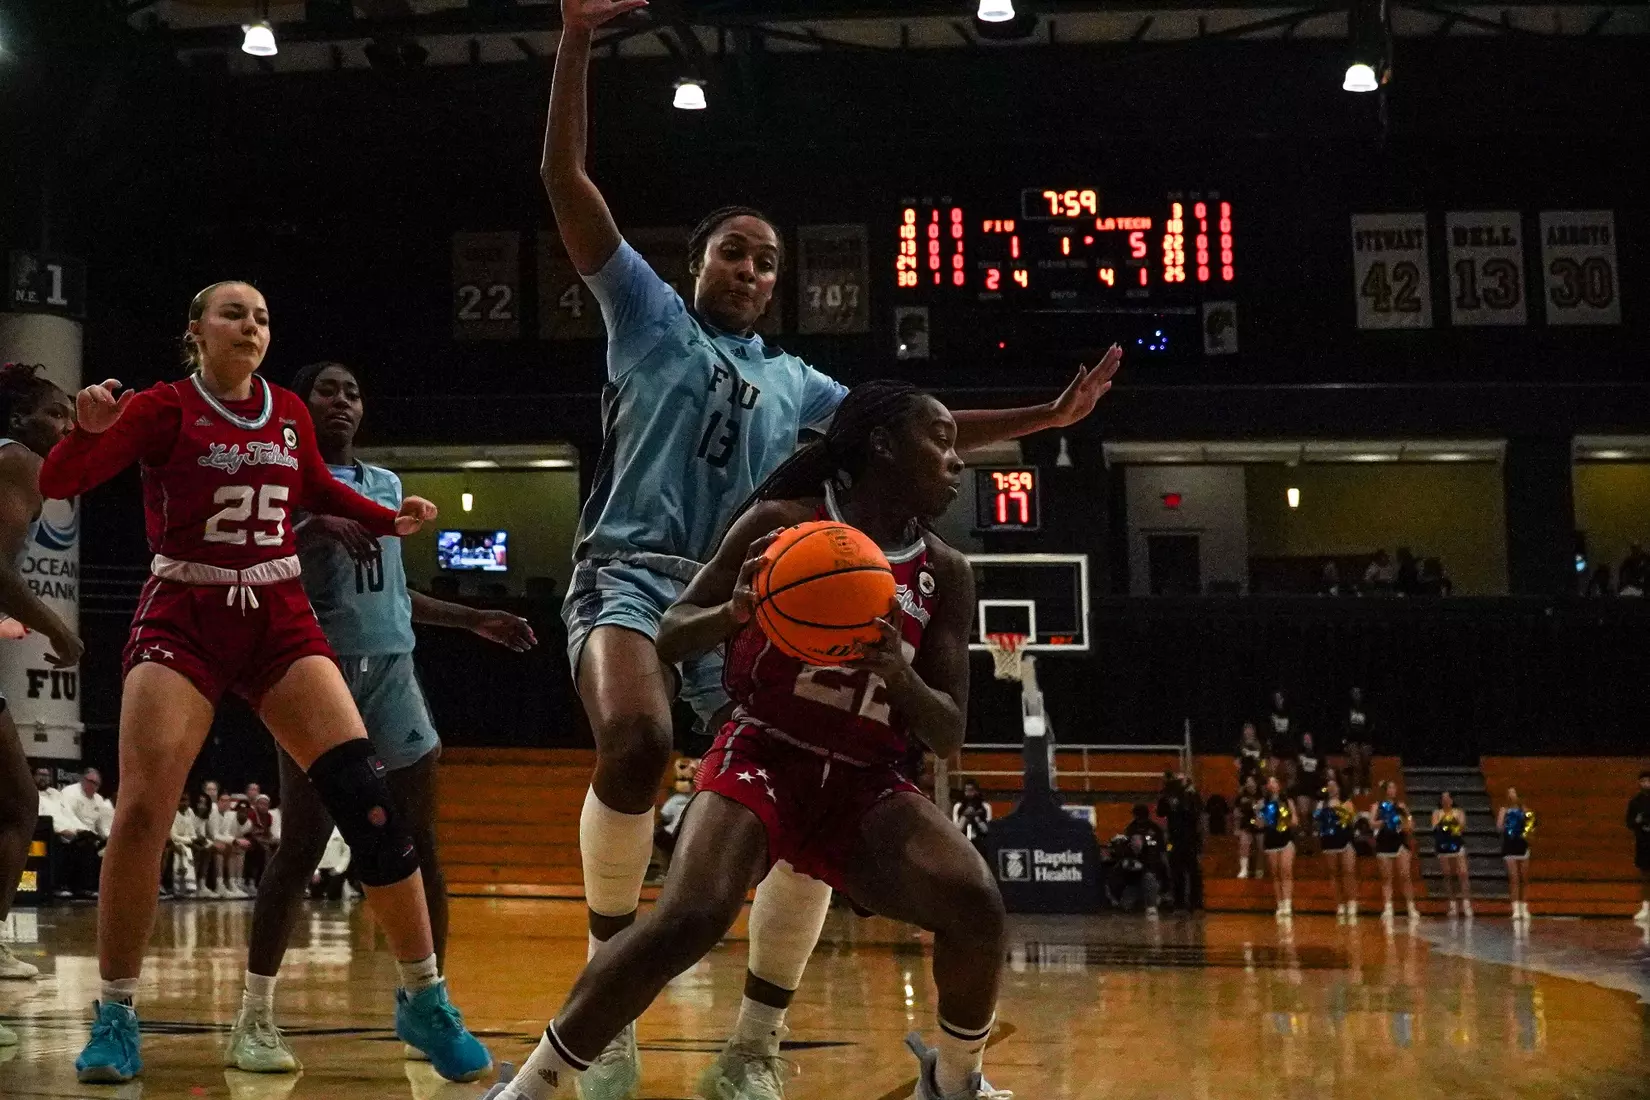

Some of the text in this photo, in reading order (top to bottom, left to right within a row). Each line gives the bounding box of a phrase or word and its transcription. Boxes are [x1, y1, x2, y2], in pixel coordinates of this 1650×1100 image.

[904, 208, 916, 223] 0
[1043, 190, 1097, 217] 7:59
[983, 220, 1014, 232] FIU
[900, 239, 917, 255] 13
[1062, 236, 1069, 255] 1
[1129, 231, 1147, 258] 5
[896, 254, 917, 270] 24
[46, 263, 68, 306] 1
[986, 268, 1001, 290] 2
[1013, 269, 1028, 288] 4
[1100, 268, 1114, 286] 4
[1139, 267, 1147, 286] 1
[1361, 260, 1422, 313] 42
[1454, 257, 1521, 310] 13
[1549, 256, 1613, 309] 30
[457, 284, 512, 320] 22
[708, 364, 761, 410] FIU
[697, 410, 740, 468] 13
[992, 471, 1033, 492] 7:59
[203, 484, 290, 546] 25
[996, 491, 1029, 524] 17
[26, 668, 77, 701] FIU
[1033, 849, 1084, 868] Baptist
[1034, 866, 1083, 882] Health
